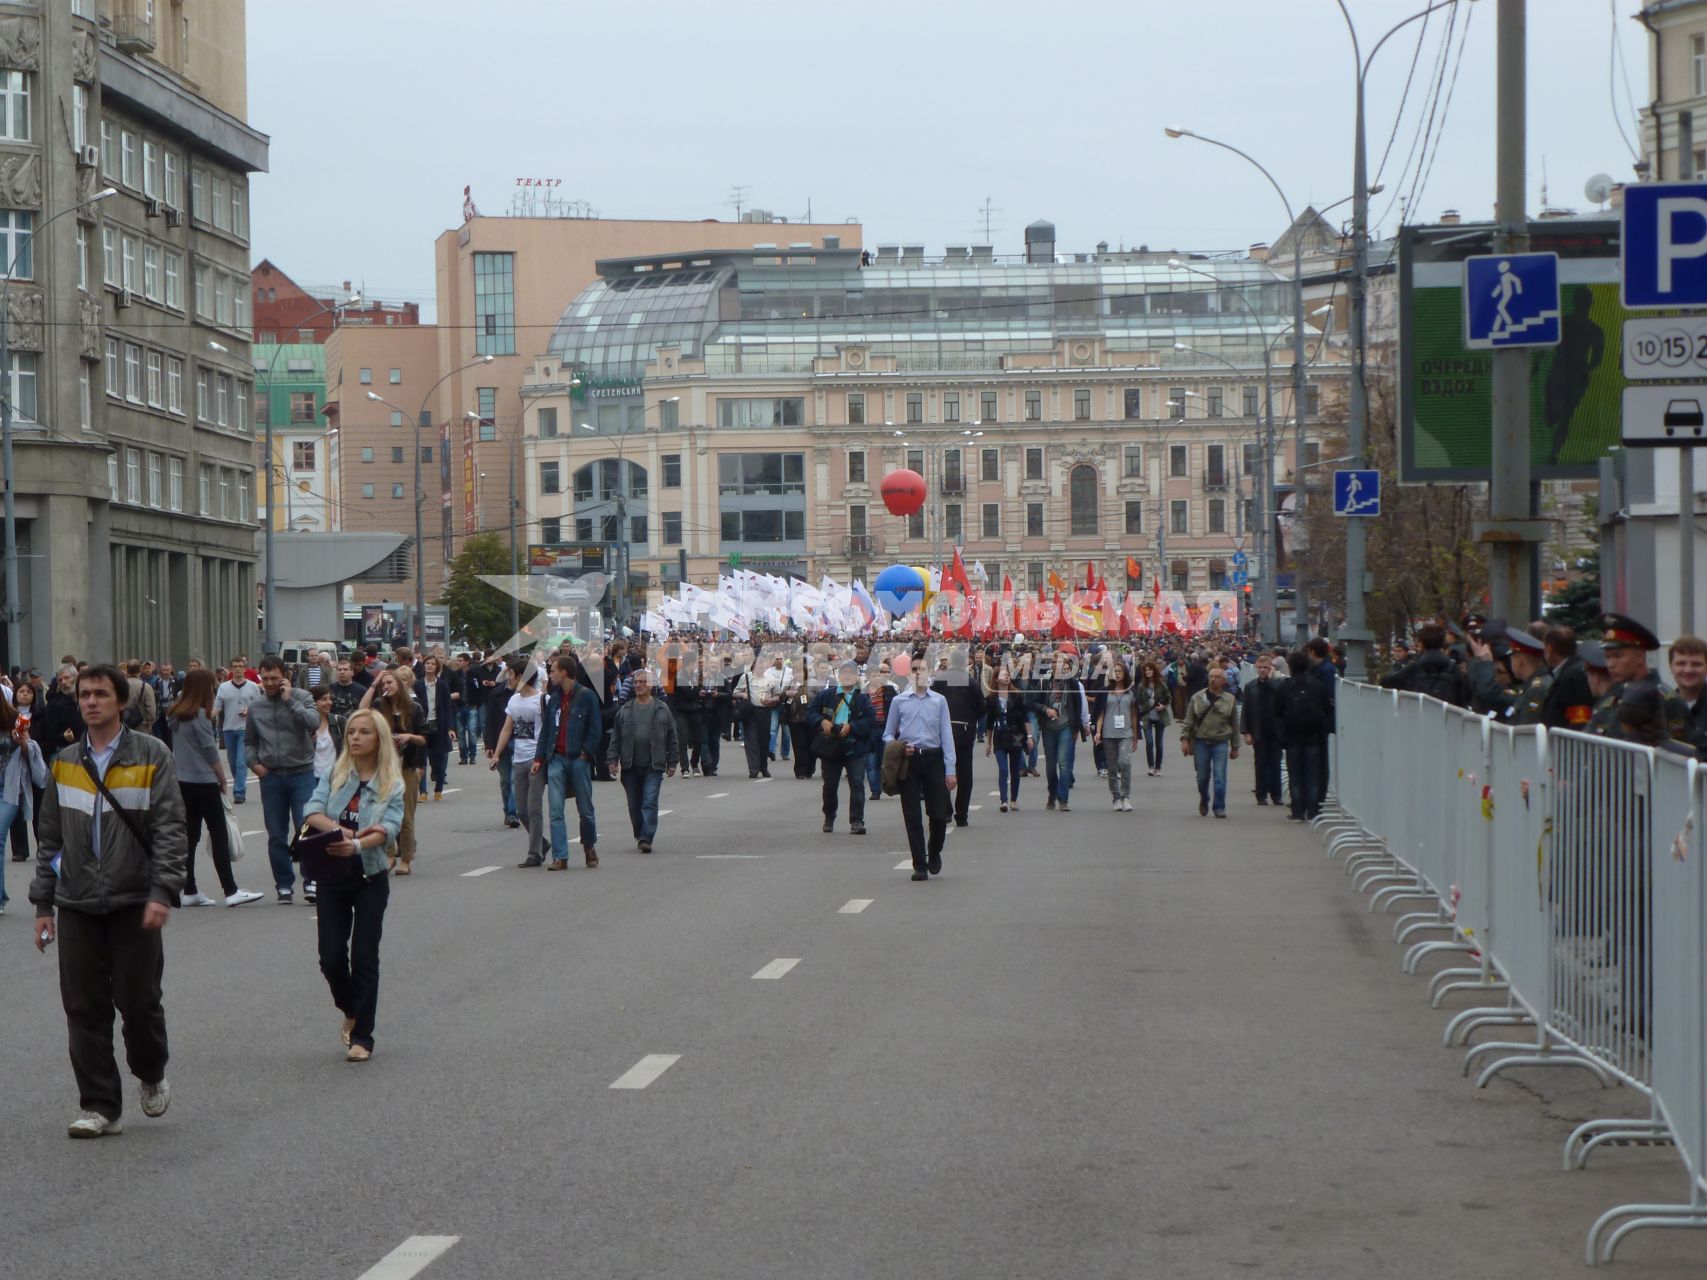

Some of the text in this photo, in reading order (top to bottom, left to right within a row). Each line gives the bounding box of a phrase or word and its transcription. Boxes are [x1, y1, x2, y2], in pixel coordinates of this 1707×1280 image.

[516, 178, 561, 187] ТЕАТР
[1657, 197, 1707, 293] P
[1637, 341, 1655, 356] 10
[1664, 337, 1685, 358] 15
